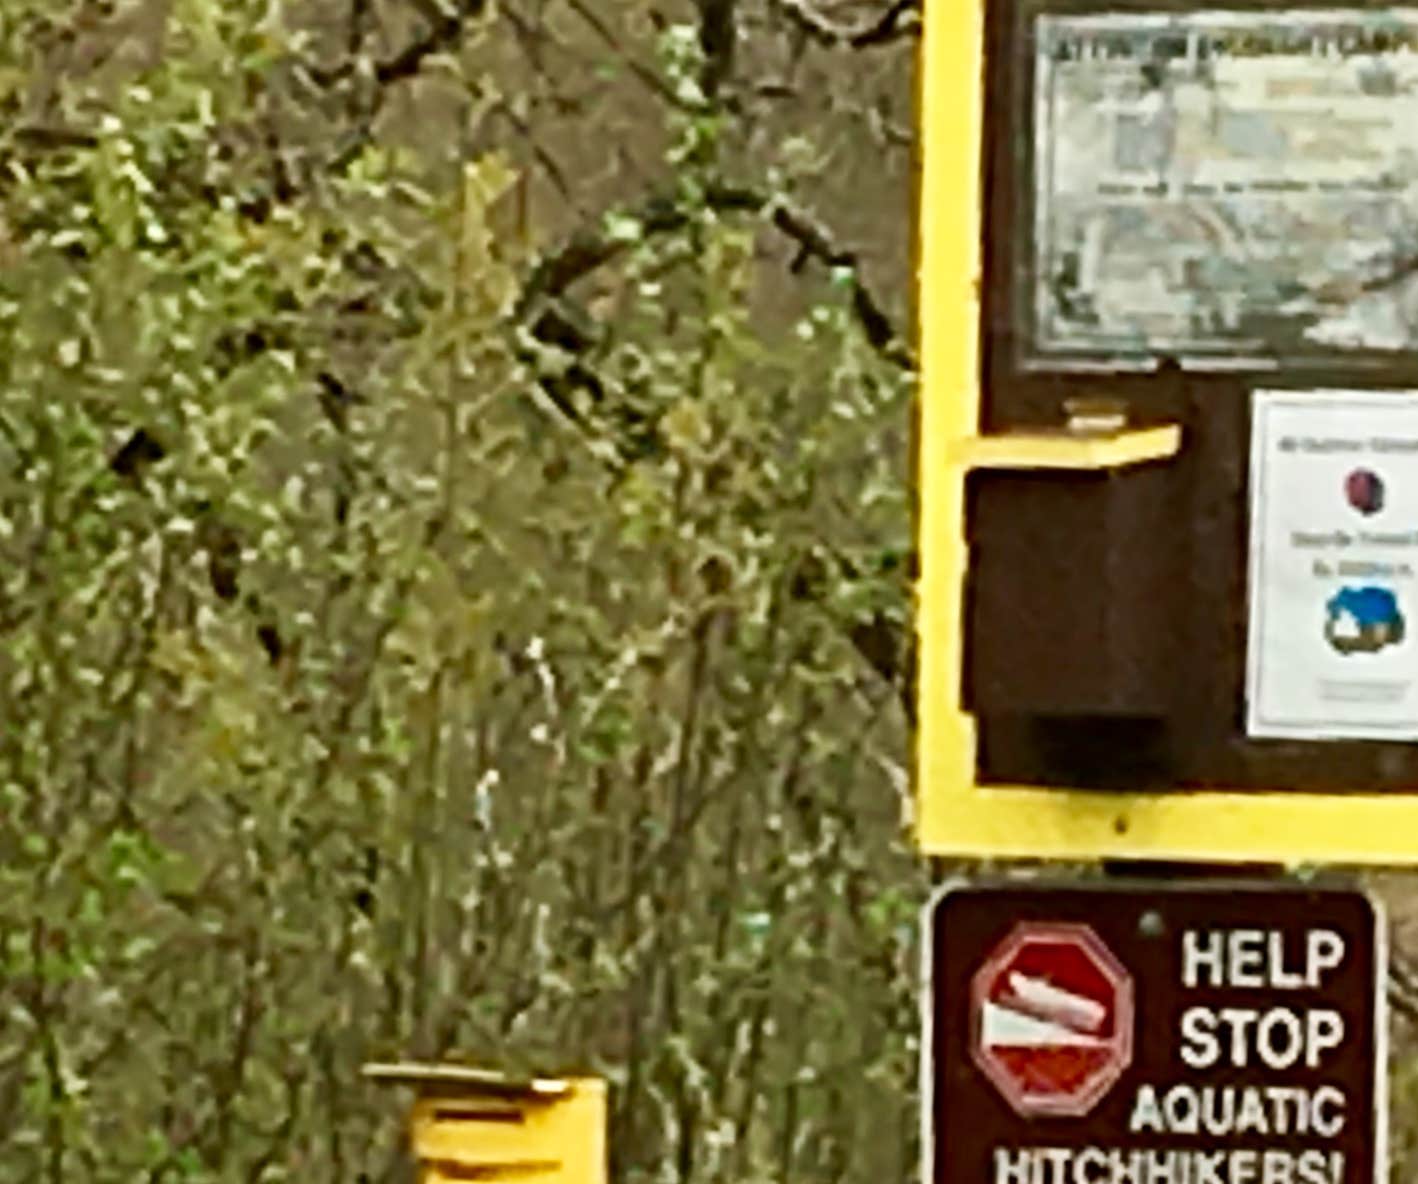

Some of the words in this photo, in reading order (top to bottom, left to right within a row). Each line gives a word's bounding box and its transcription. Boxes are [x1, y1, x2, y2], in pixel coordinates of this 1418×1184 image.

[1183, 929, 1345, 989] HELP
[1180, 1007, 1344, 1069] STOP
[1130, 1085, 1345, 1137] AQUATIC
